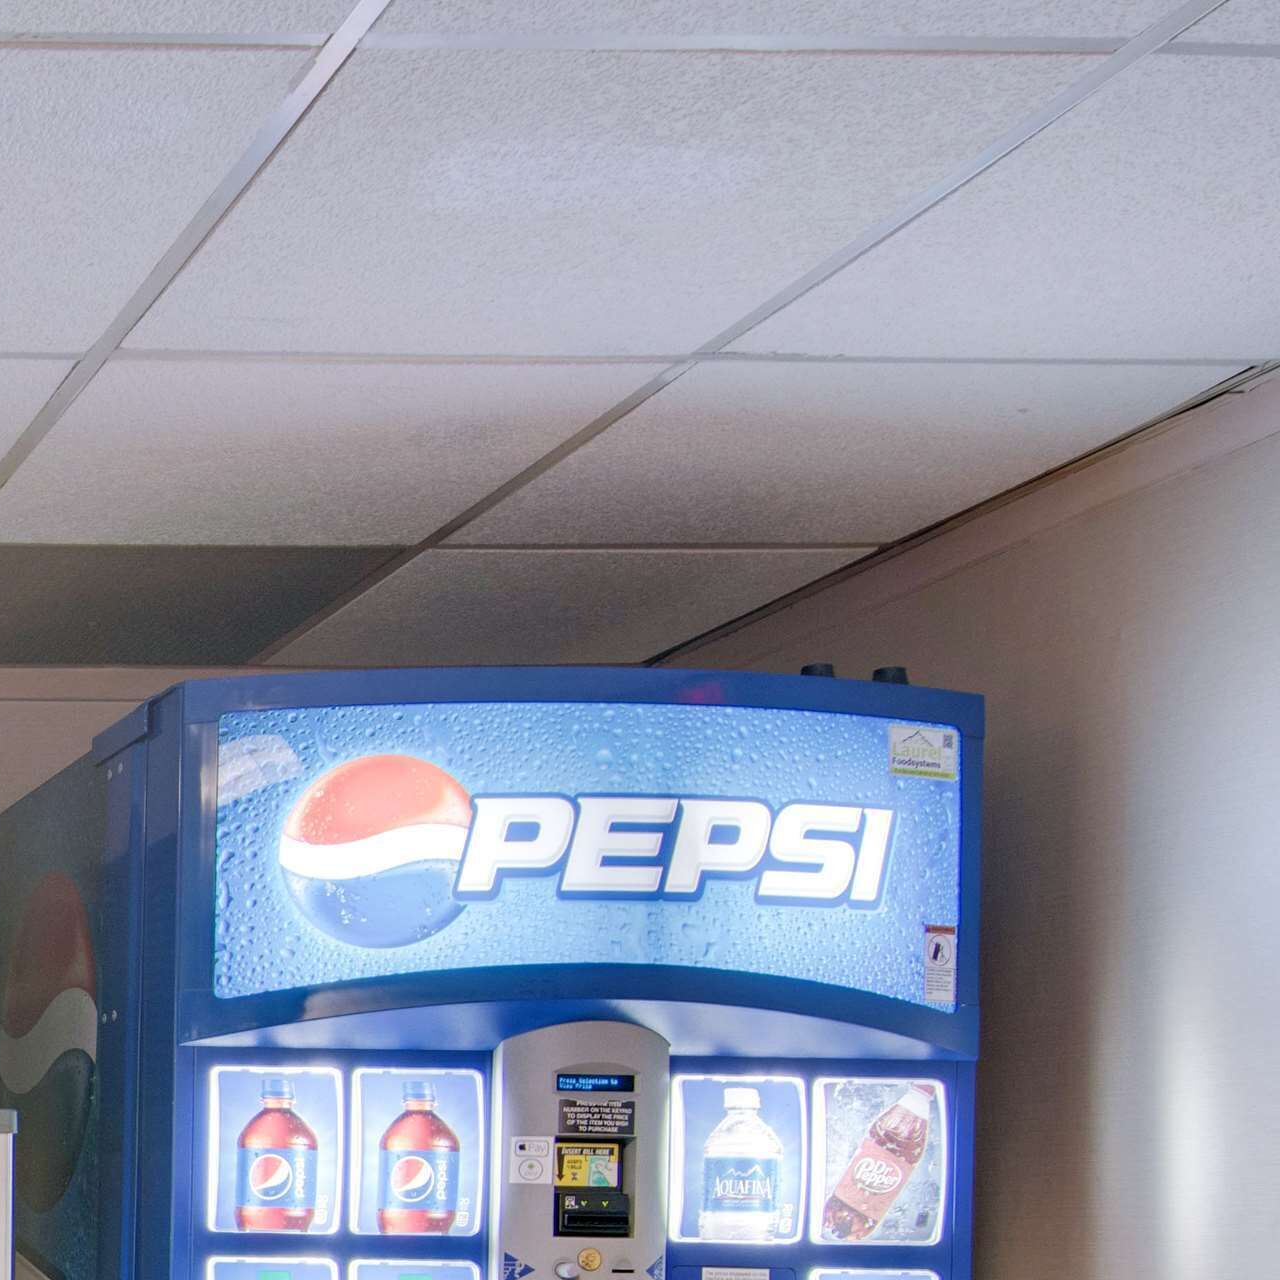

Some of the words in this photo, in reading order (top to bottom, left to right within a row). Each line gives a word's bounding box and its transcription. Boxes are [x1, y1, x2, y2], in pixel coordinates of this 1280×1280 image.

[891, 756, 942, 769] Foodsystems
[452, 793, 896, 906] PEPSI
[856, 1158, 901, 1187] Pepper
[874, 1158, 892, 1177] Dr
[713, 1175, 773, 1199] AQUAFINA
